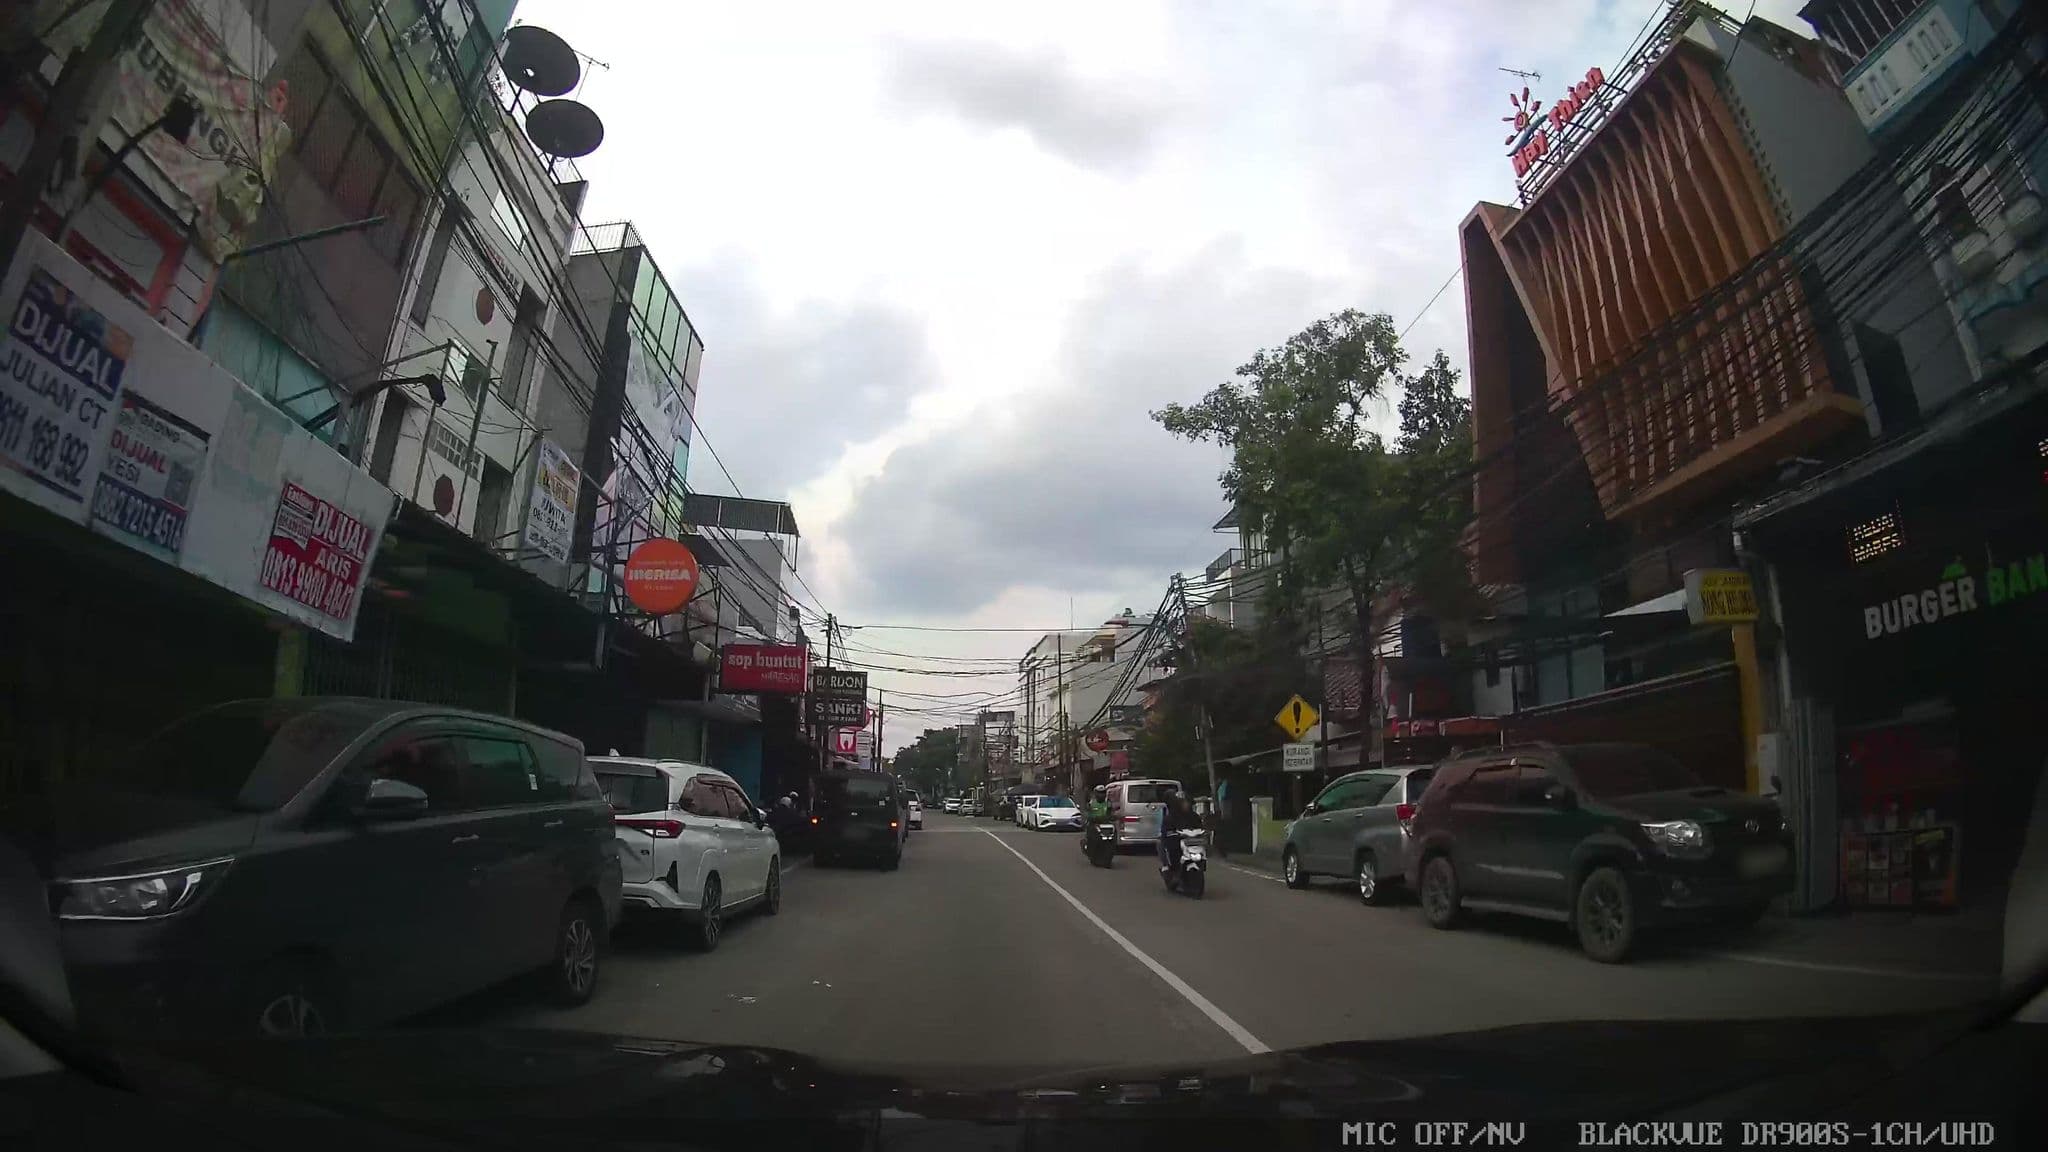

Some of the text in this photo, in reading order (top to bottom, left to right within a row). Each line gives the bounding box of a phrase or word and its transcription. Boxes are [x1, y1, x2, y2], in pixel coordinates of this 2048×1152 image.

[15, 300, 114, 394] DIJUAL
[0, 350, 107, 430] JULIAN CT
[0, 391, 29, 450] 811
[110, 428, 168, 475] DIJUAL
[312, 500, 368, 560] DIJUAL
[315, 547, 352, 581] ARIS
[1864, 576, 1979, 641] BURGER
[727, 651, 803, 670] sop buntut
